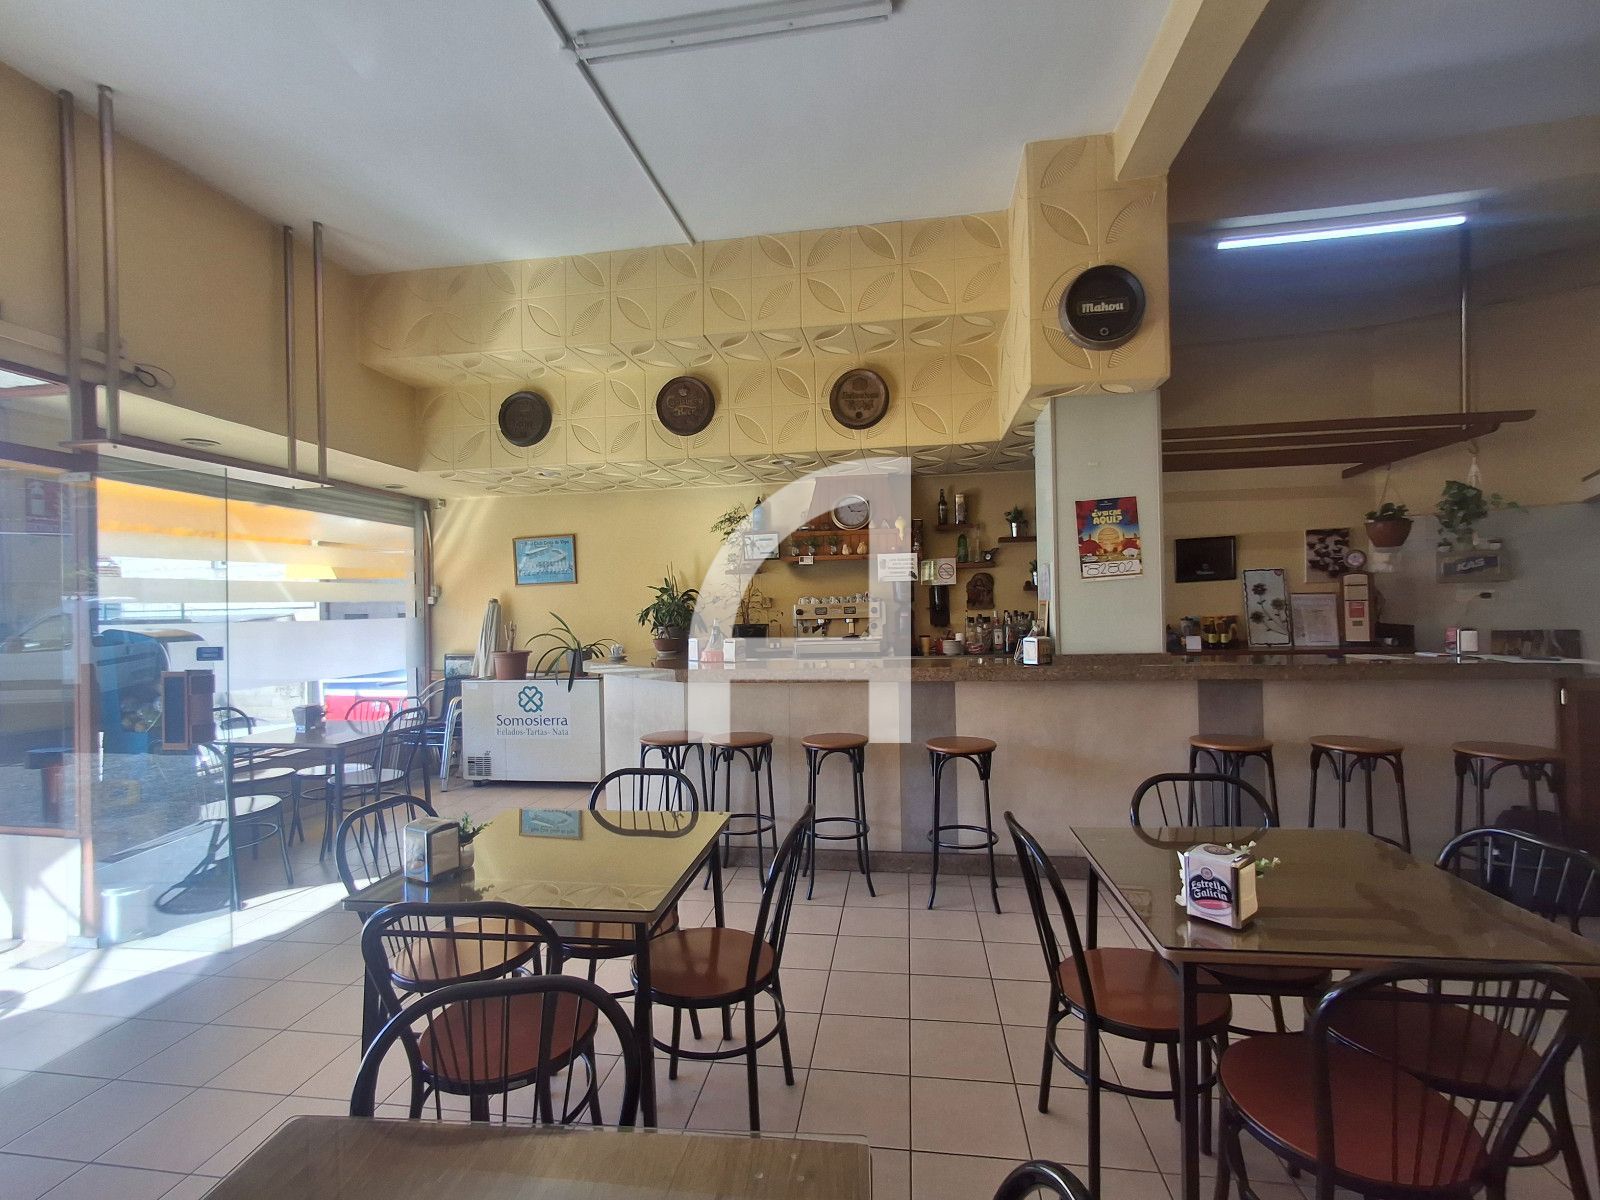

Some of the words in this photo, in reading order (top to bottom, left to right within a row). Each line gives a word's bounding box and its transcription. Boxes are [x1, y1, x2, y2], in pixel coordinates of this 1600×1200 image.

[1081, 302, 1124, 314] Mahou
[496, 714, 569, 727] Somosierra
[1191, 880, 1227, 893] Estrella
[1194, 889, 1228, 901] Galicia
